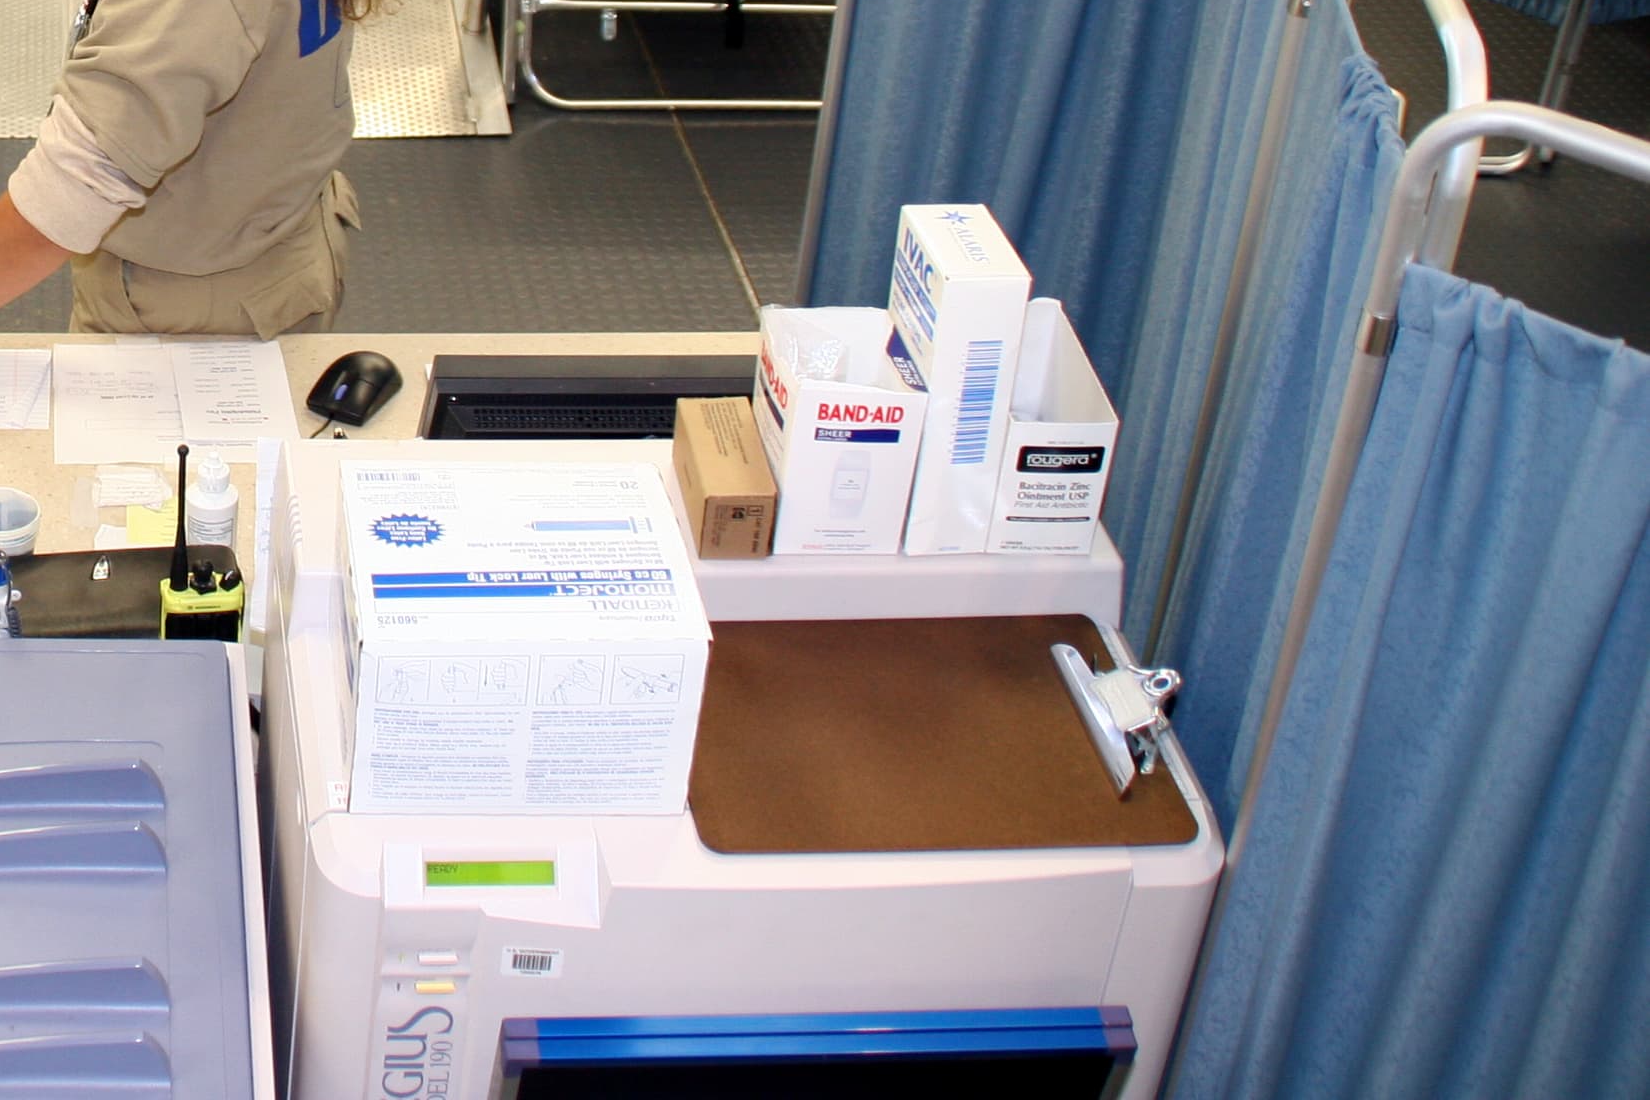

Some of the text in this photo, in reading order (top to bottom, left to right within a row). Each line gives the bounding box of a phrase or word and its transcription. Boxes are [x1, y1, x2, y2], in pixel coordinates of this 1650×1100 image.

[904, 228, 935, 294] IVAC
[893, 356, 917, 387] SHEER
[818, 403, 904, 423] BAND-AID
[818, 430, 852, 438] SHEER
[1019, 482, 1091, 491] Bacitracin Zinc
[1017, 491, 1090, 500] Ointment USP
[466, 572, 486, 582] Tip
[488, 572, 519, 582] Lock
[522, 571, 548, 581] Luer
[550, 571, 578, 581] with
[580, 570, 631, 581] Syringes
[652, 571, 667, 581] 60
[588, 600, 675, 611] KENDALL
[428, 864, 459, 874] READY
[382, 1006, 453, 1100] GIUS
